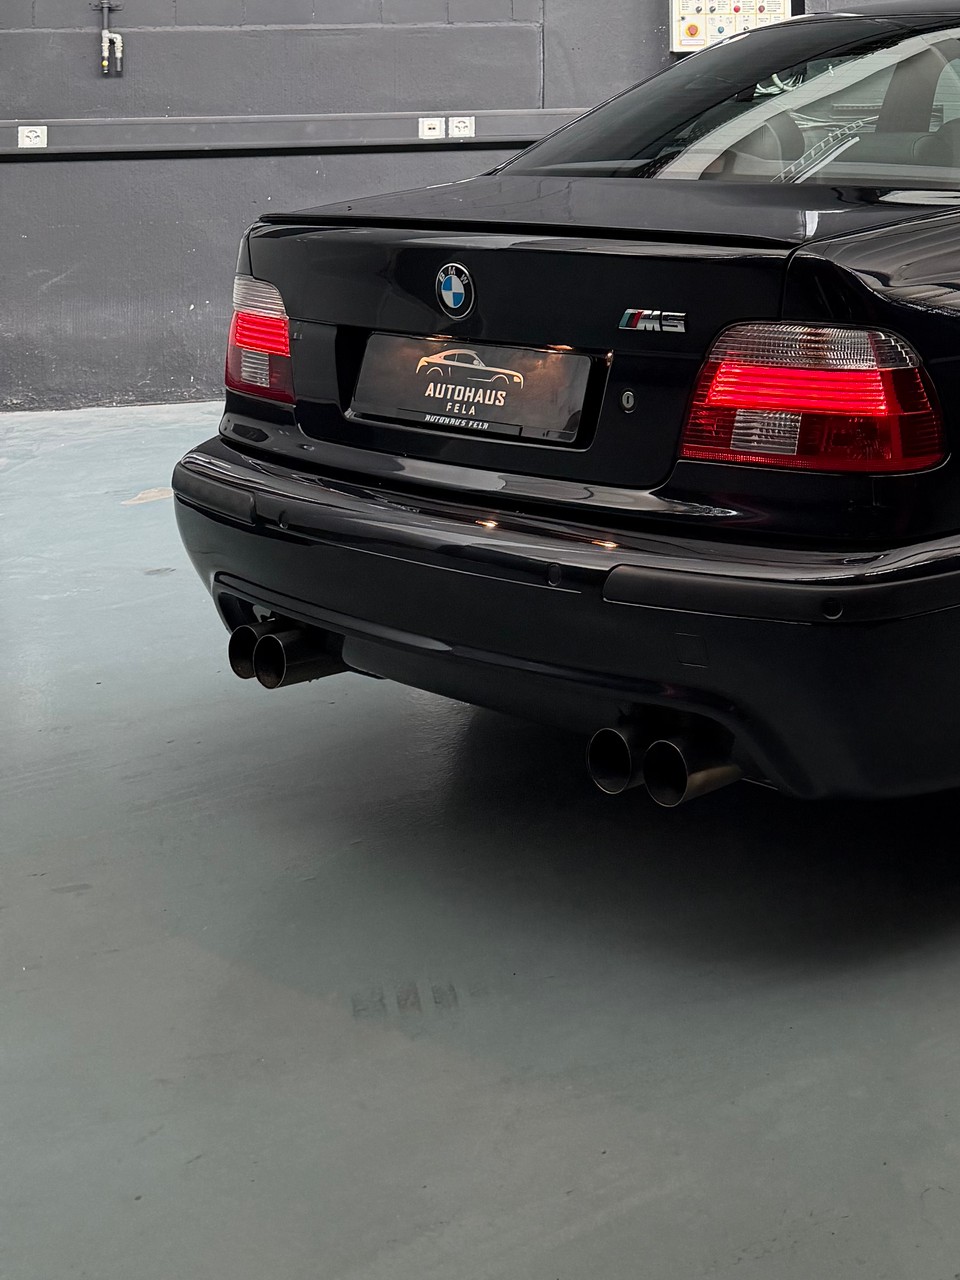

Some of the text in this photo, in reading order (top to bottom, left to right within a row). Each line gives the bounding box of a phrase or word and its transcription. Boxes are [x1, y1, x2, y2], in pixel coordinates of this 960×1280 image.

[438, 266, 469, 285] BMW
[631, 309, 686, 332] M5
[424, 382, 507, 406] AUTOHAUS
[446, 402, 476, 416] FELA
[424, 414, 489, 430] AUTOHAUS FELA
